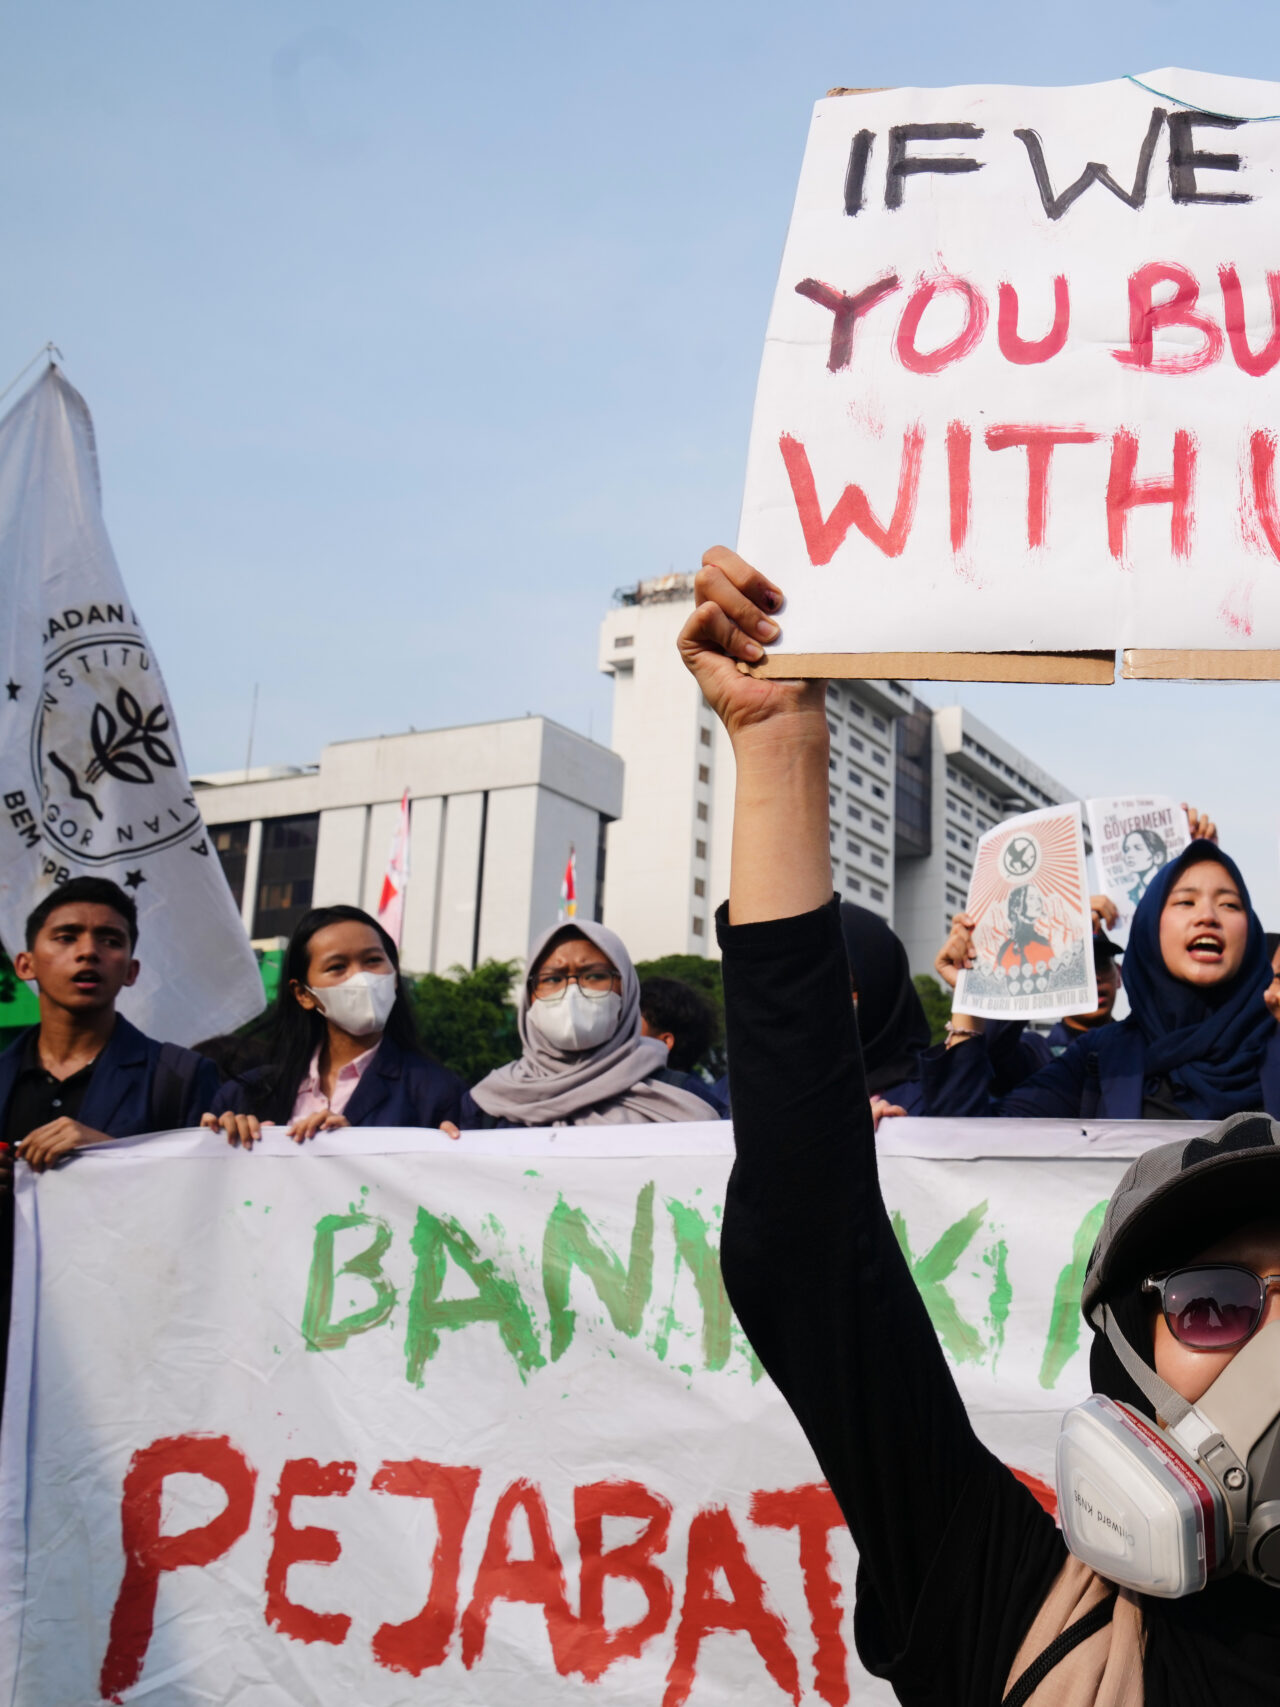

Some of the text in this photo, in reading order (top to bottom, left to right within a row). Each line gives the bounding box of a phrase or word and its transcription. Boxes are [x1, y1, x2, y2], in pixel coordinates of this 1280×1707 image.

[843, 121, 987, 217] IF
[1013, 106, 1262, 221] WE
[795, 262, 1070, 375] YOU
[778, 419, 1198, 572] WITH
[3, 790, 41, 848] BEM
[100, 1430, 862, 1707] PEJABAT
